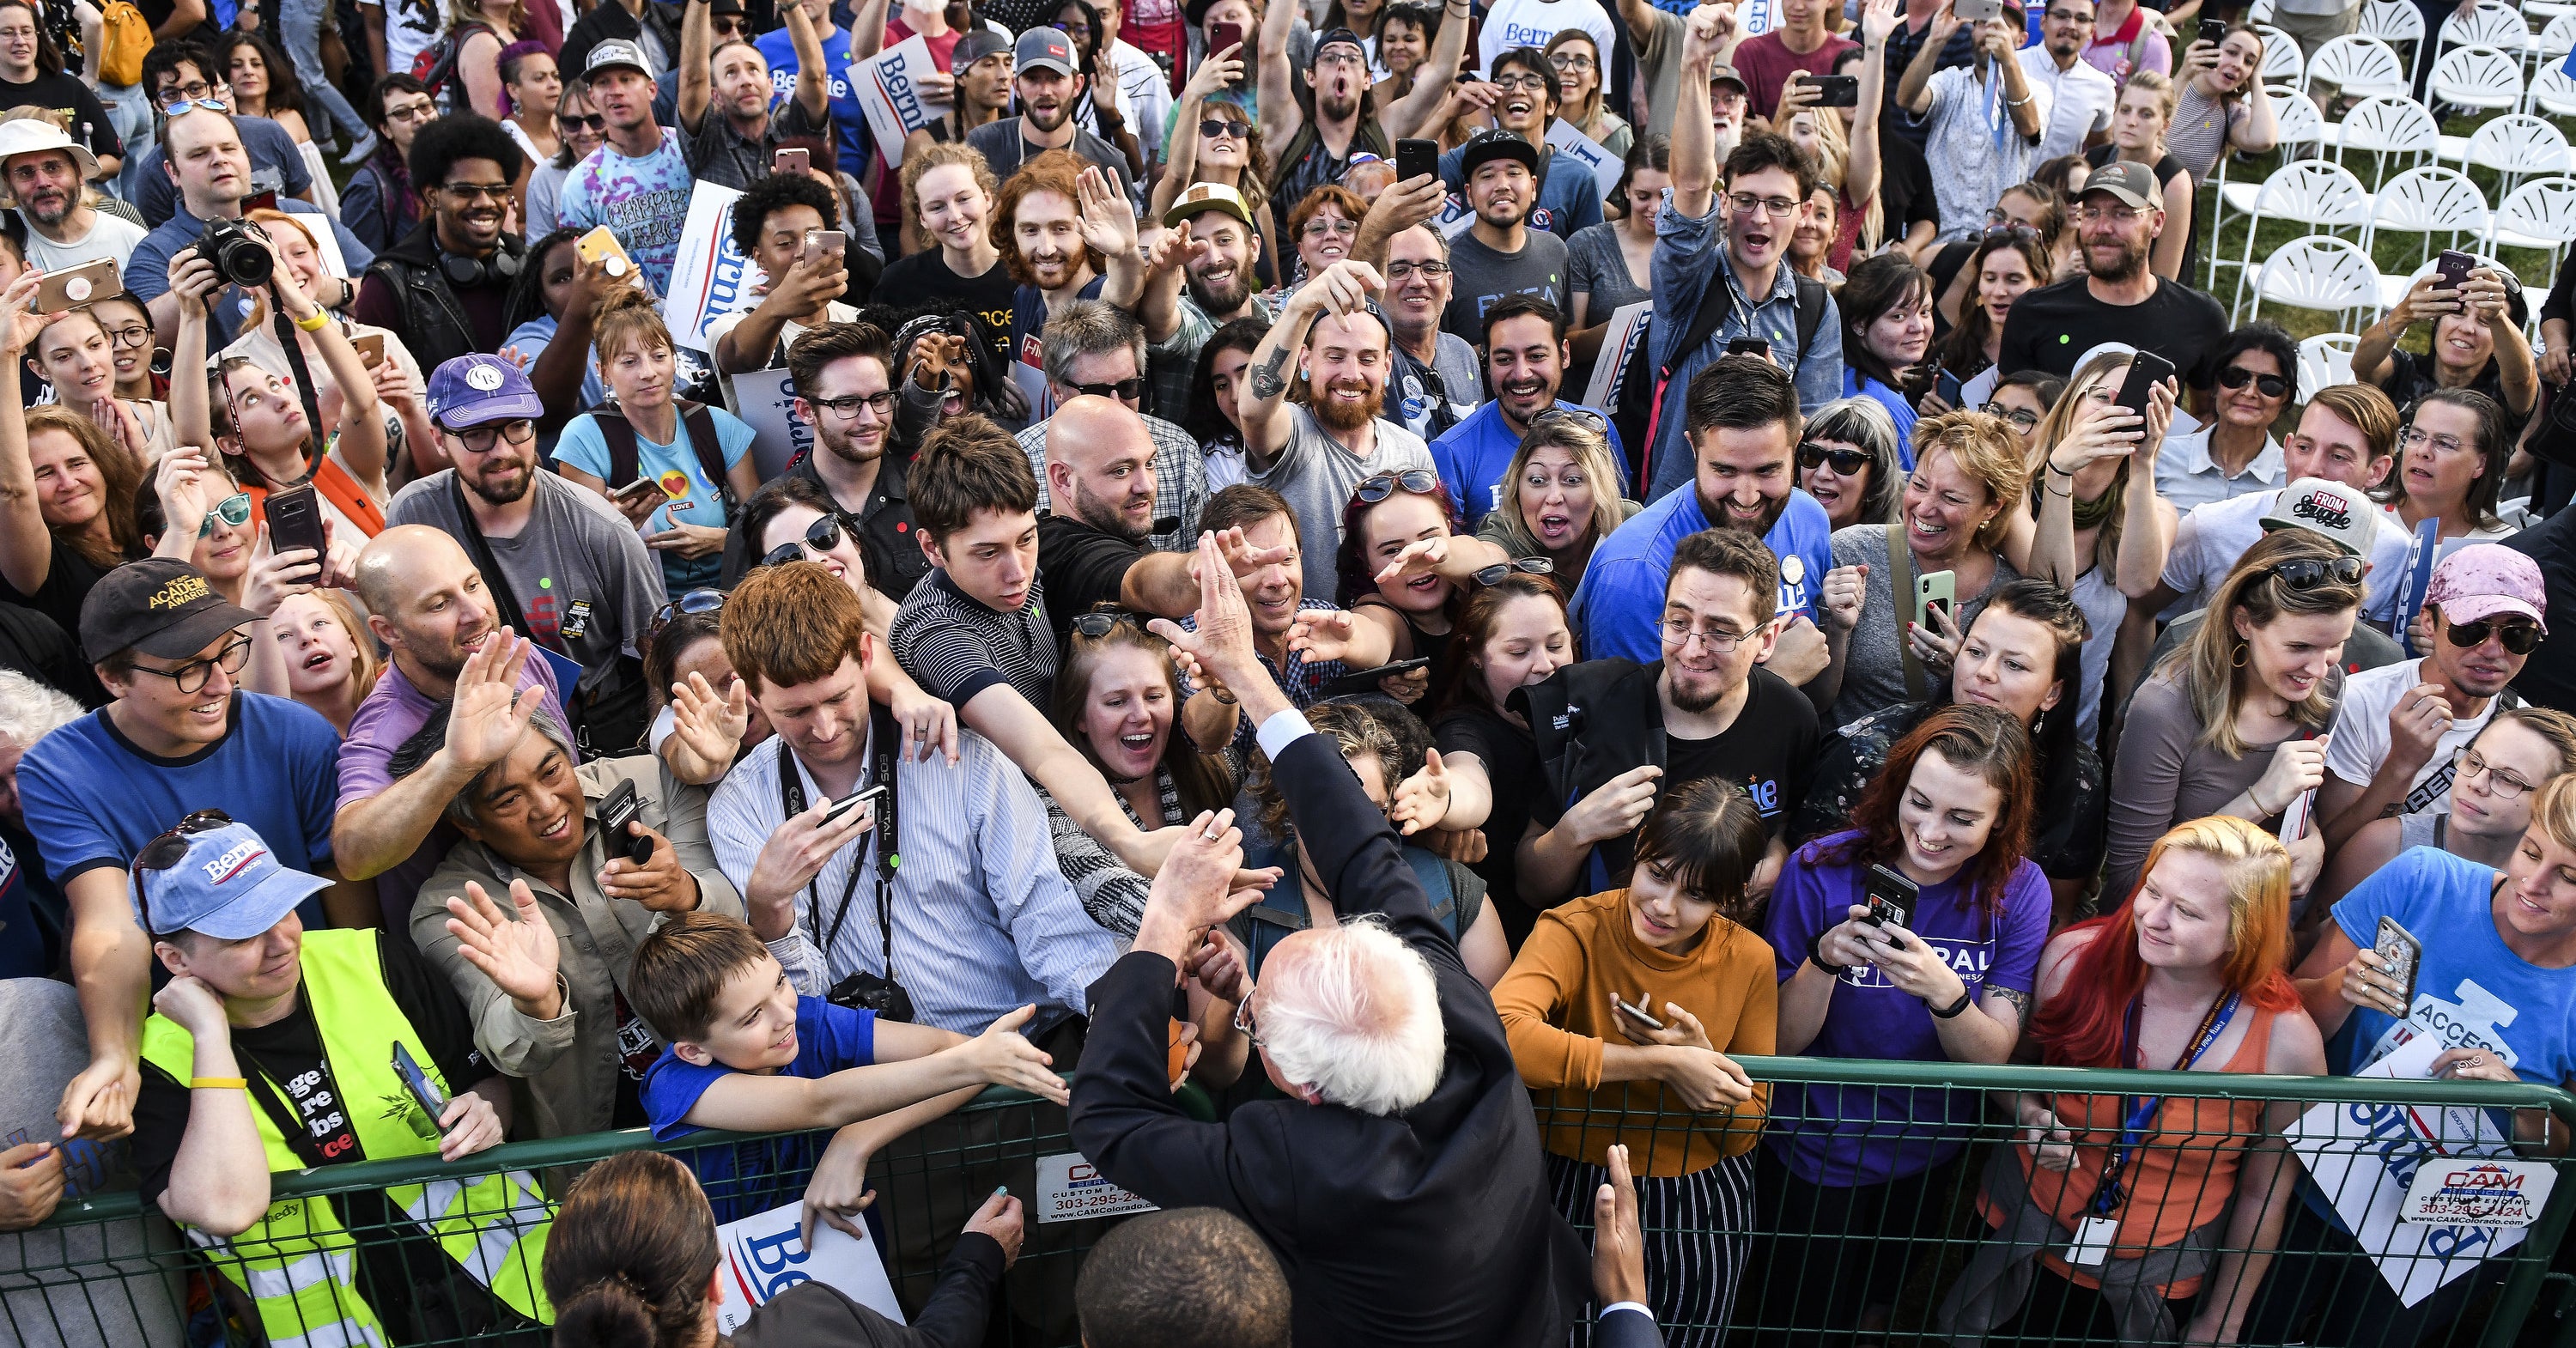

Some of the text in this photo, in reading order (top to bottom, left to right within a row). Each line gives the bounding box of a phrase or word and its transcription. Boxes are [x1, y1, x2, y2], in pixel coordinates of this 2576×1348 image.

[1505, 23, 1552, 46] Bern
[773, 70, 847, 99] Beie
[879, 52, 933, 135] Berni
[608, 188, 690, 228] CHERR
[699, 212, 745, 339] erni
[671, 502, 691, 511] LOVE
[2313, 492, 2346, 512] FROM
[167, 587, 210, 610] AWARDS
[2392, 534, 2424, 644] Ber
[788, 786, 800, 817] Can
[879, 753, 892, 841] EOS ITAL
[1738, 774, 1777, 811] ie
[201, 839, 264, 882] Bernie
[307, 1111, 343, 1138] bs
[1052, 1187, 1103, 1199] CUSTOM
[2350, 1103, 2488, 1266] Bnie
[2444, 1172, 2525, 1190] CAM
[2419, 1204, 2524, 1217] 303-295-2424
[2421, 1195, 2531, 1205] CUSTOM FENCING
[2410, 1216, 2524, 1226] www.CAMColorado.com
